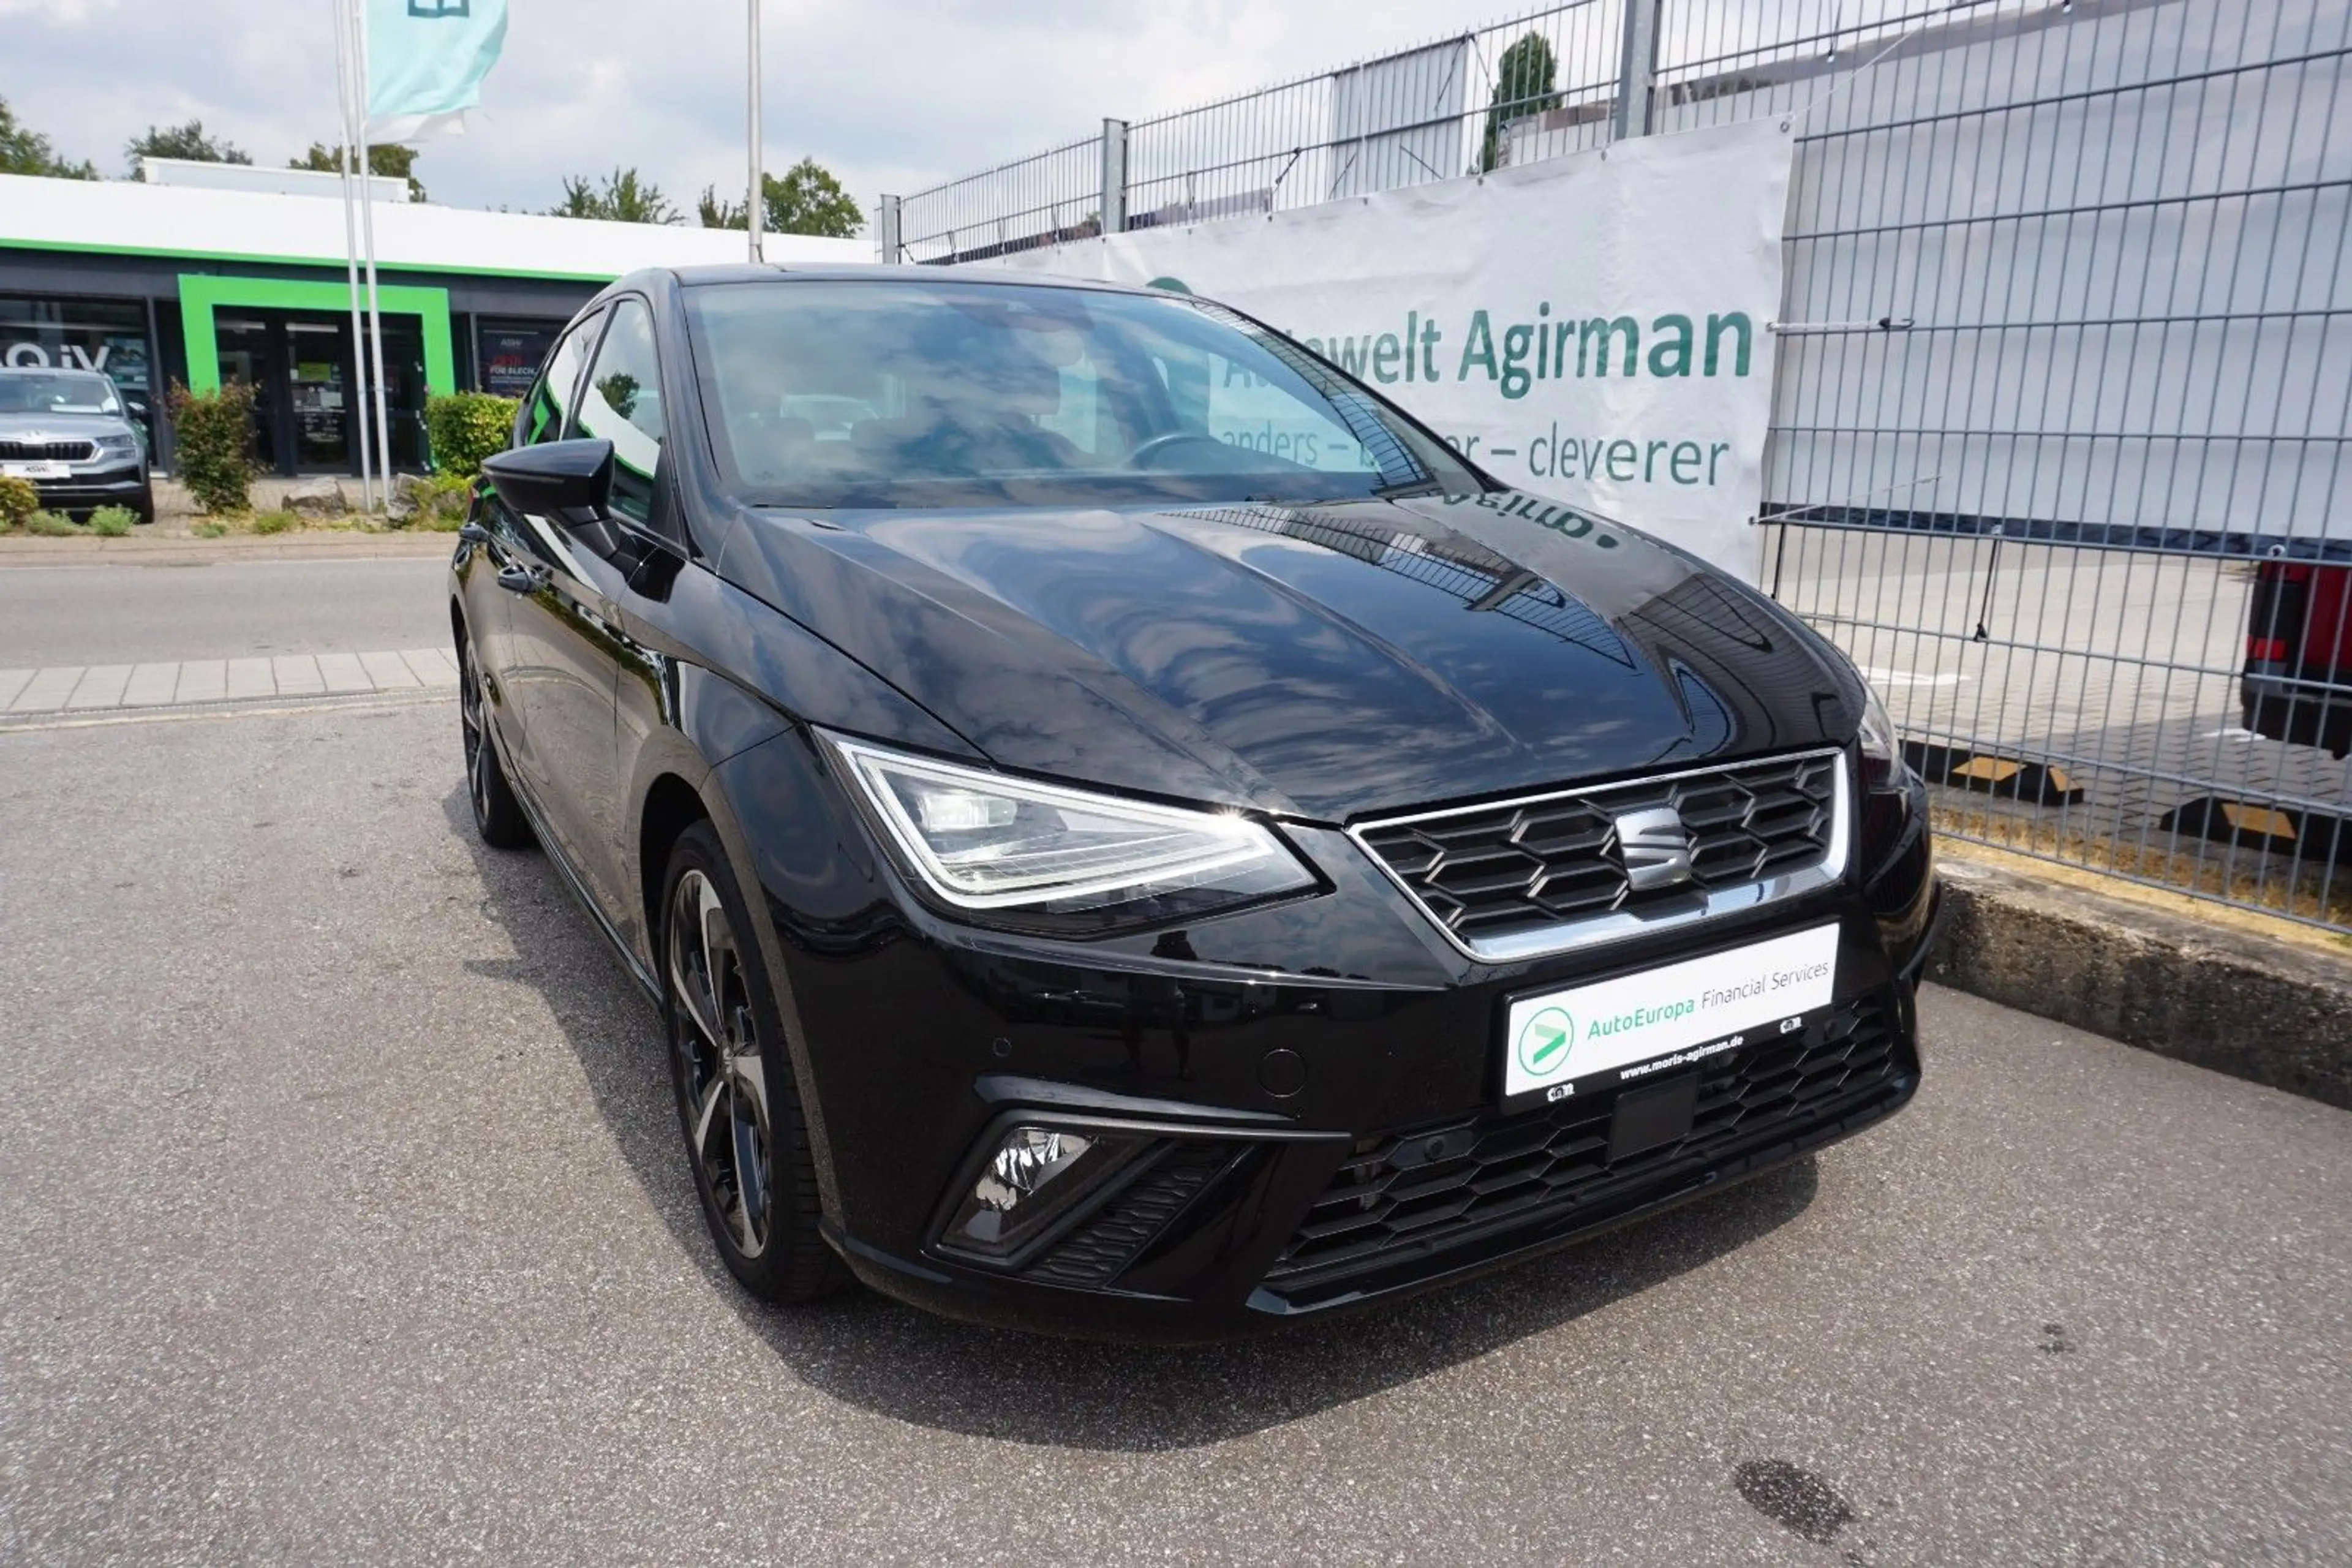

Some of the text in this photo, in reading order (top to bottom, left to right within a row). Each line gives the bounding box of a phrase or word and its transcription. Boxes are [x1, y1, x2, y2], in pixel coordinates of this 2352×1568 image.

[1458, 301, 1752, 399] Agirman
[1529, 420, 1730, 486] cleverer
[1588, 960, 1830, 1041] AutoEuropa Financial Services
[1620, 1035, 1744, 1080] www.moris-agirman.de
